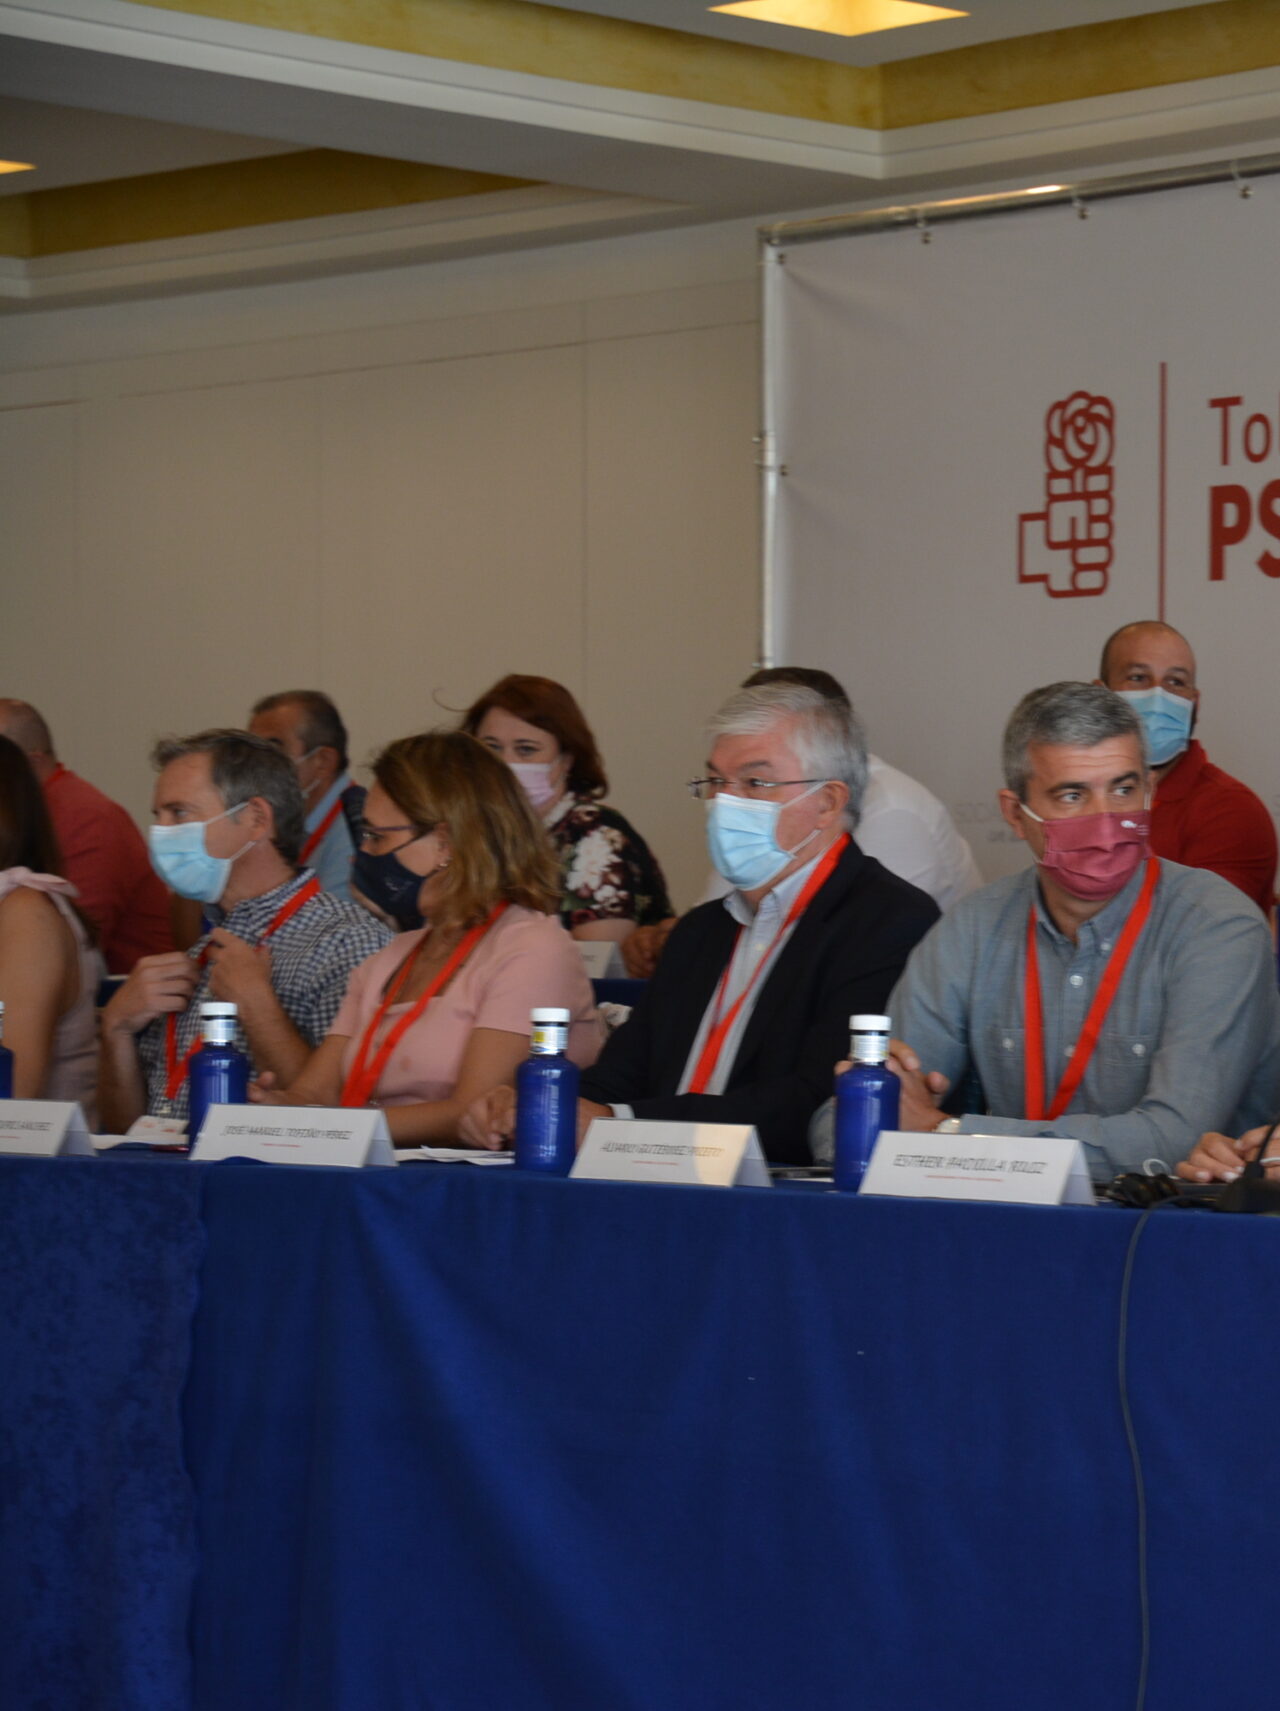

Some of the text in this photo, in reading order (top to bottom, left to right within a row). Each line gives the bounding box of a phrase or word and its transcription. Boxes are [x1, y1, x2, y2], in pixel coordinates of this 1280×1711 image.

[892, 1153, 1048, 1175] ESTHER PADILLA RUIZ
